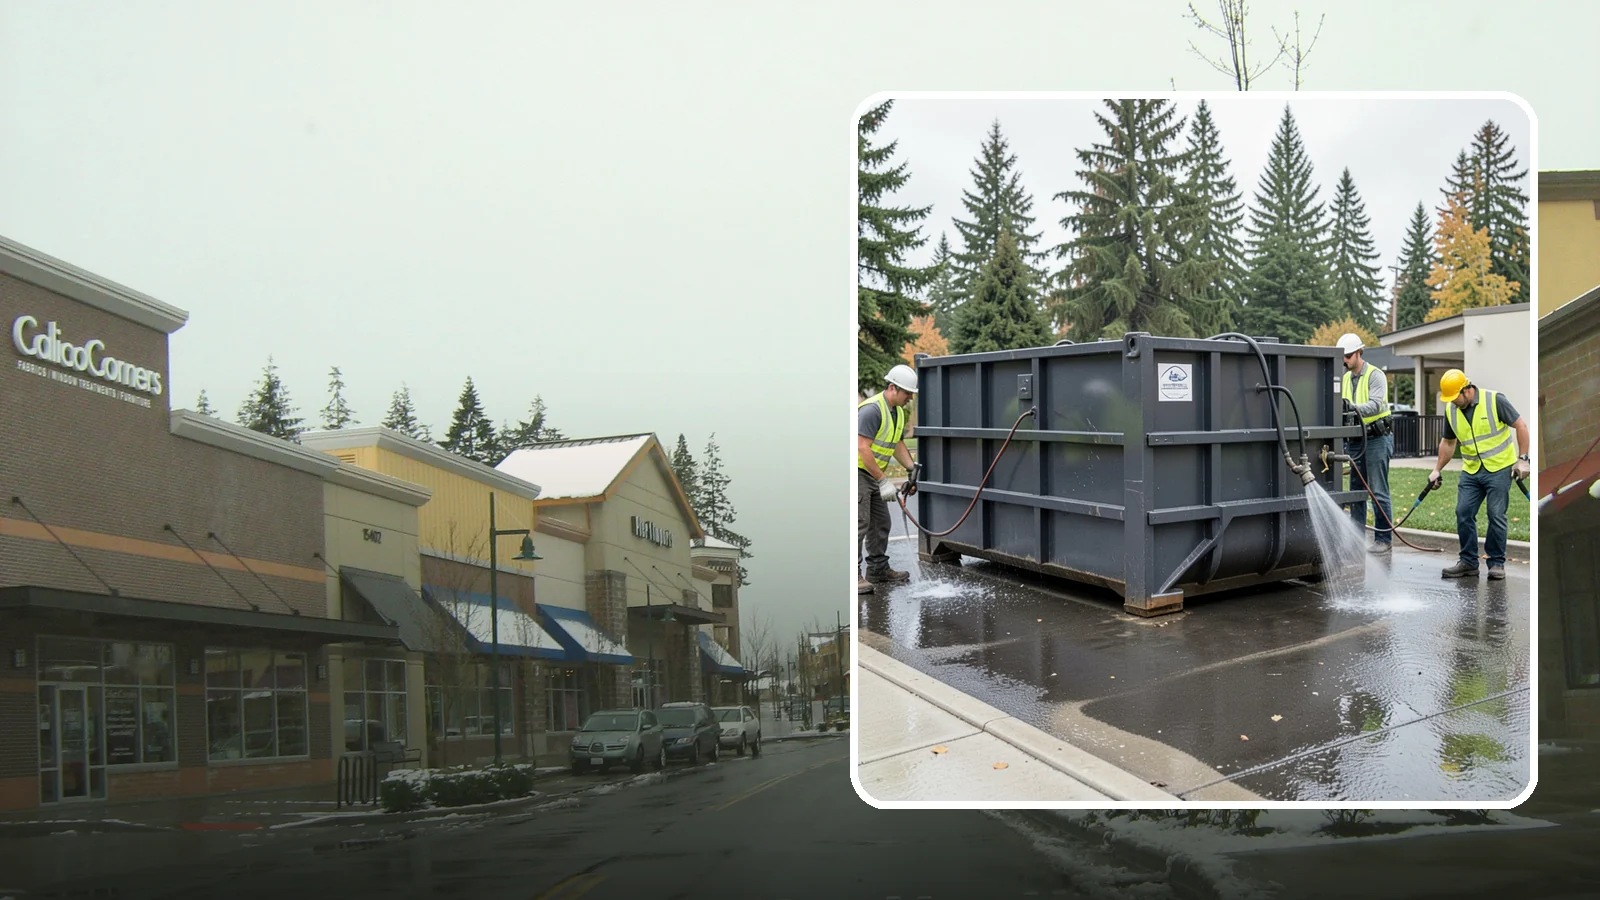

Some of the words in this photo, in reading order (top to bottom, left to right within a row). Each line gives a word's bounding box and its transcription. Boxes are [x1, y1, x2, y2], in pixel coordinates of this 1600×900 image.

[17, 360, 47, 378] FABRICS
[51, 370, 78, 387] WINDOW
[78, 378, 117, 398] TREATMENTS
[120, 391, 151, 408] FURNITURE
